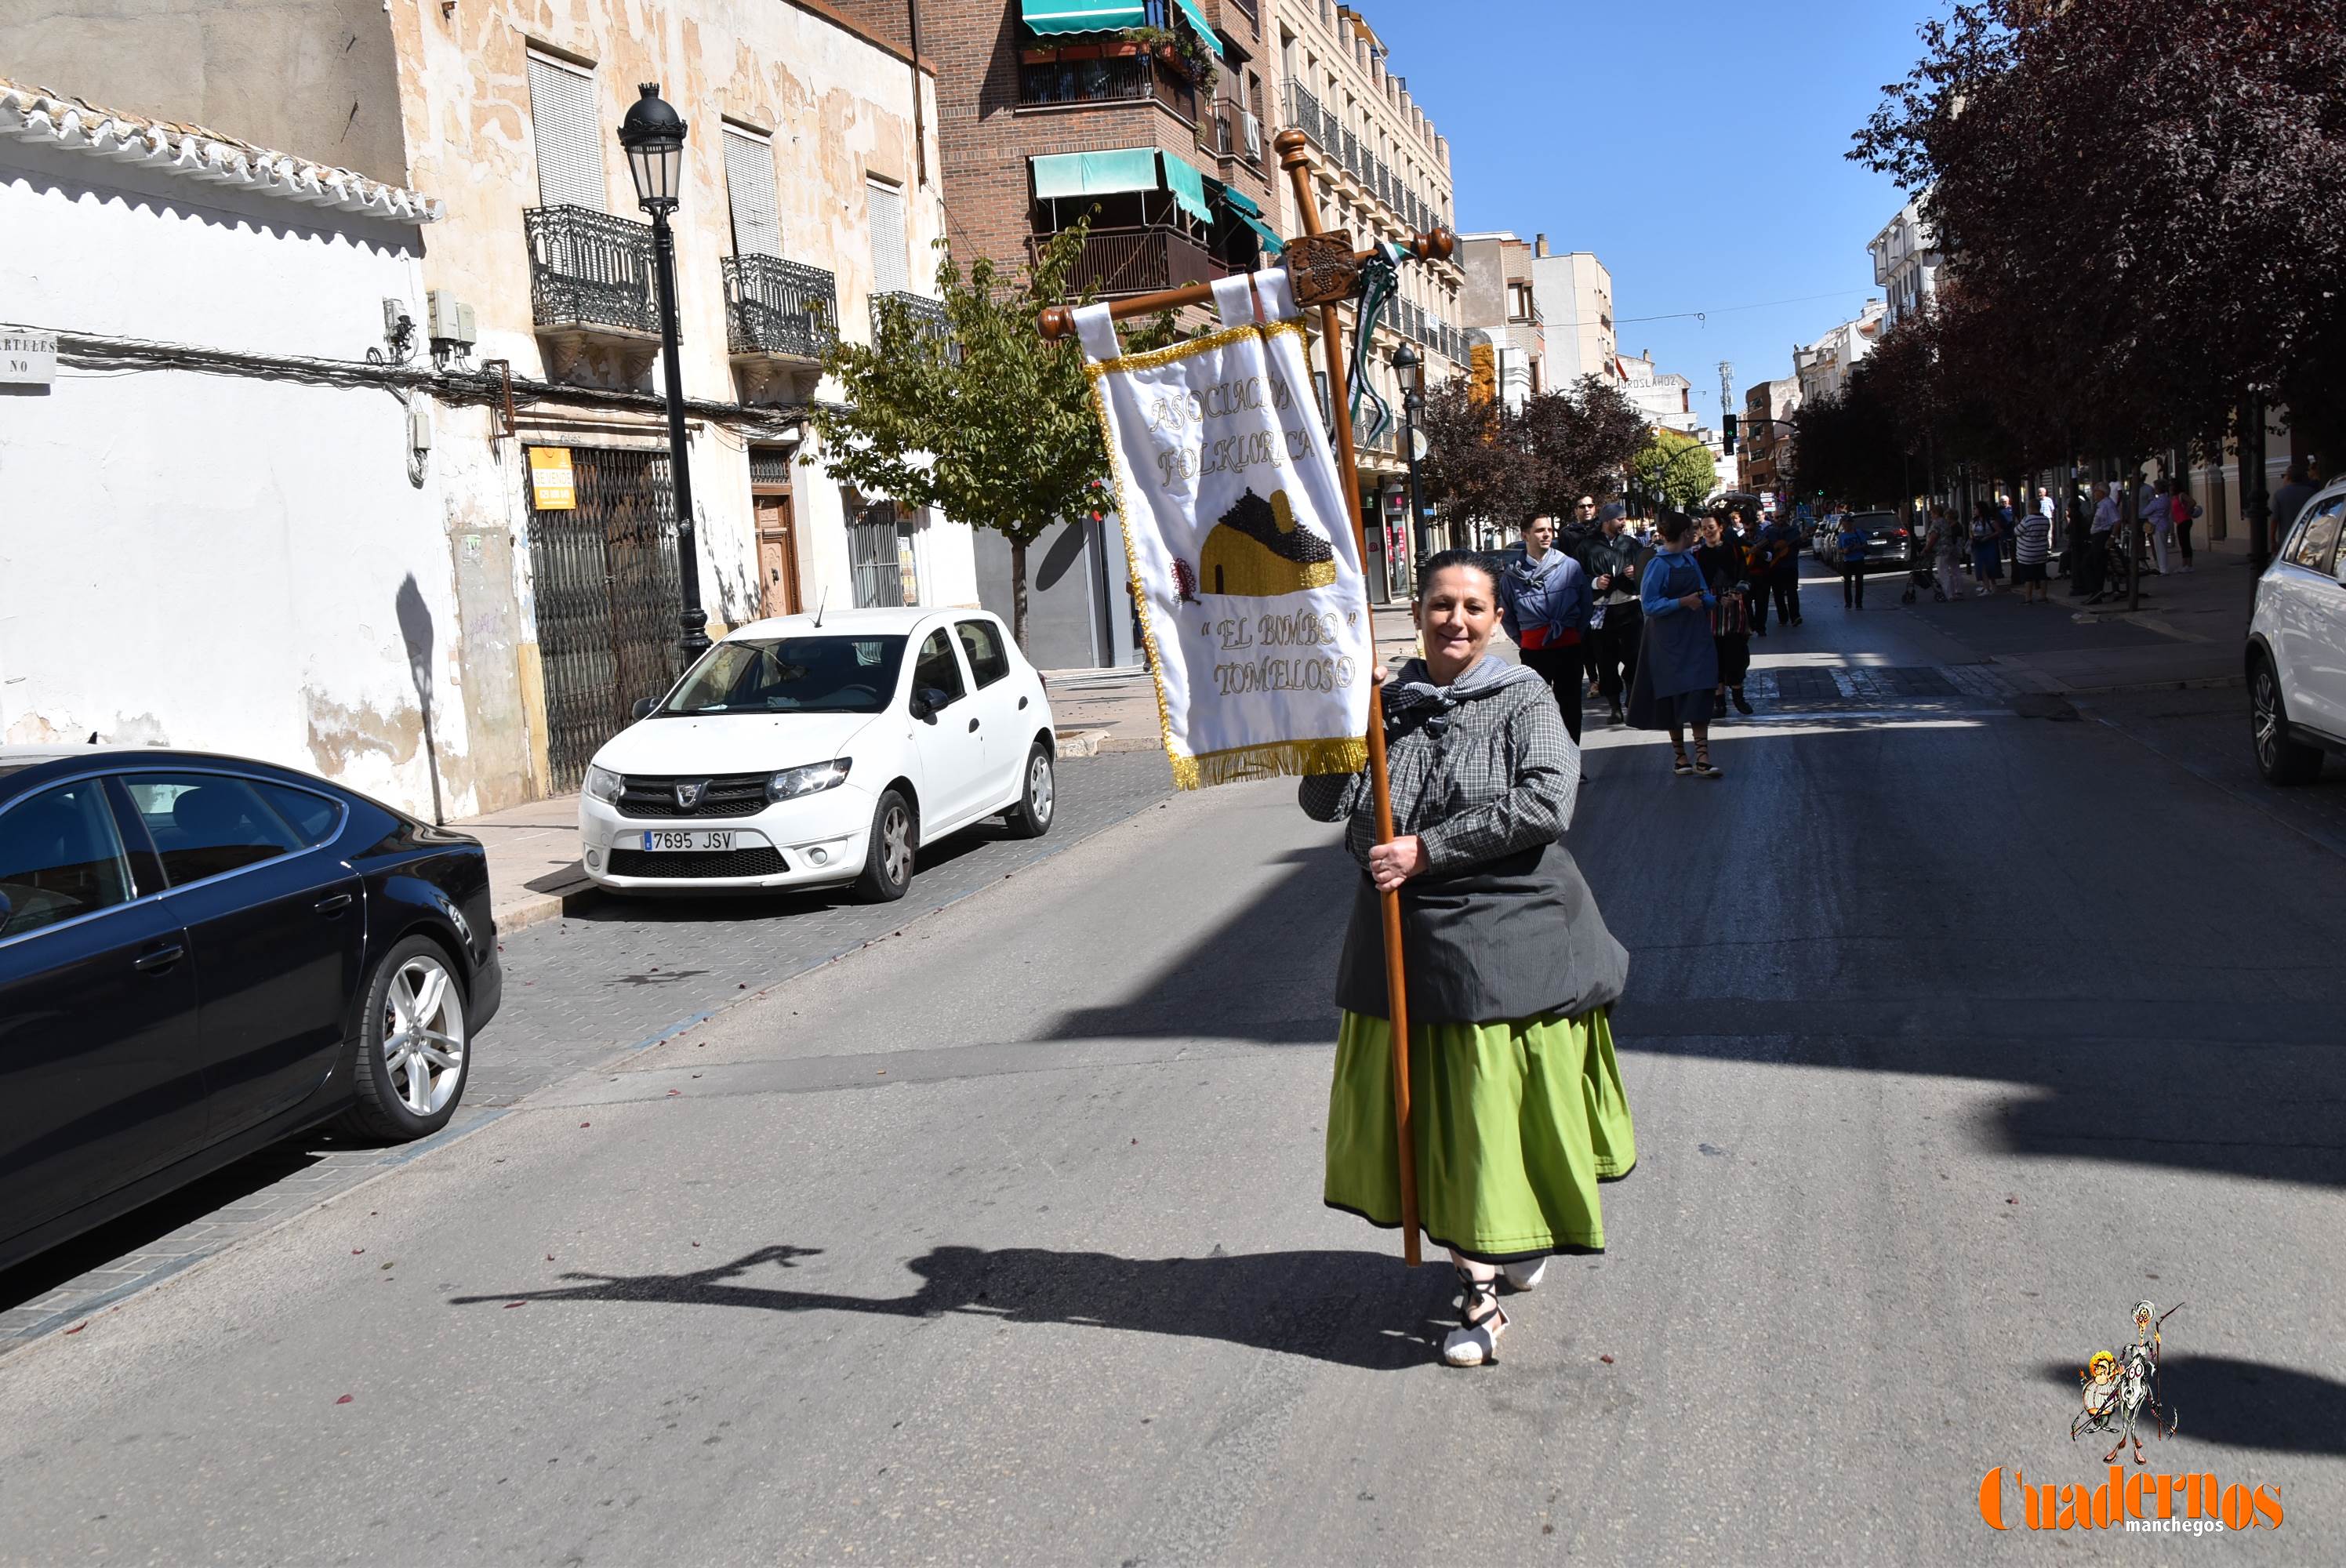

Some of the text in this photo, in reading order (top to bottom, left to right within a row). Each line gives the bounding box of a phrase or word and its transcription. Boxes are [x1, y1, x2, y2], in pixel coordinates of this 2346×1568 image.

[9, 360, 27, 372] NO
[1157, 426, 1316, 487] FOLKLORICA
[1214, 655, 1356, 695] TOMELLOSO
[654, 833, 692, 848] 7695
[703, 832, 731, 848] JSV
